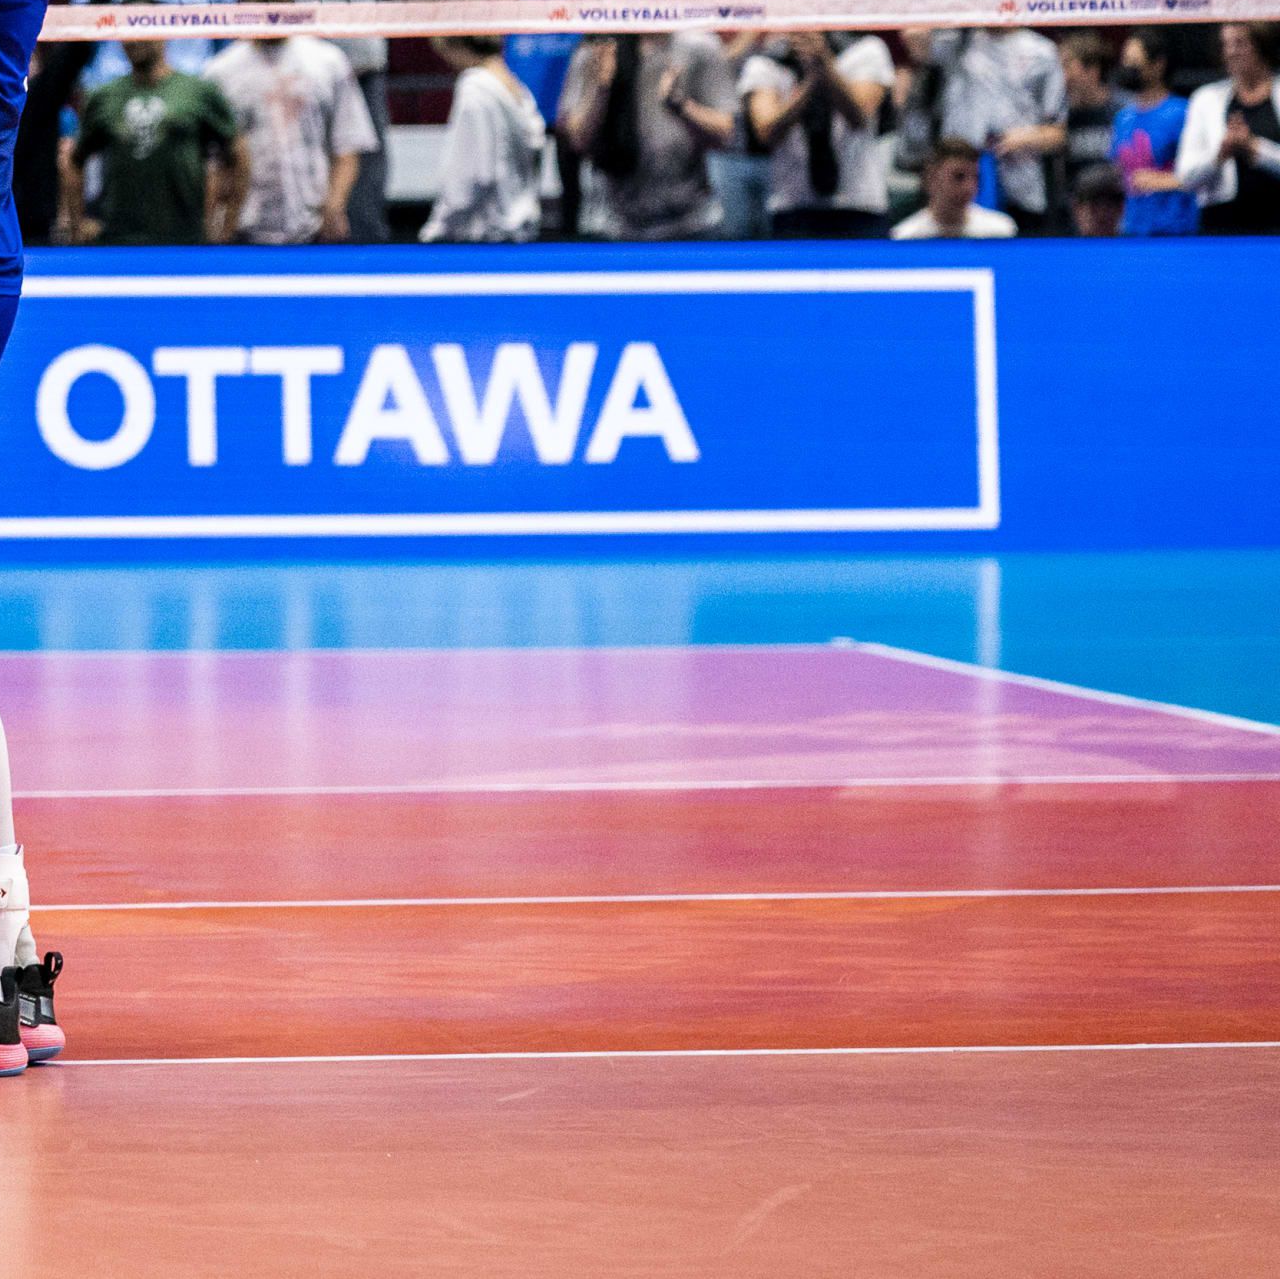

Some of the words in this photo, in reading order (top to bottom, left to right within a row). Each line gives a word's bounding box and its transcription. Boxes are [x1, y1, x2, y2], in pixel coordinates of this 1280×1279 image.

[1026, 0, 1126, 12] VOLLEYBALL
[579, 7, 680, 20] VOLLEYBALL
[127, 14, 228, 27] VOLLEYBALL
[35, 340, 701, 471] OTTAWA
